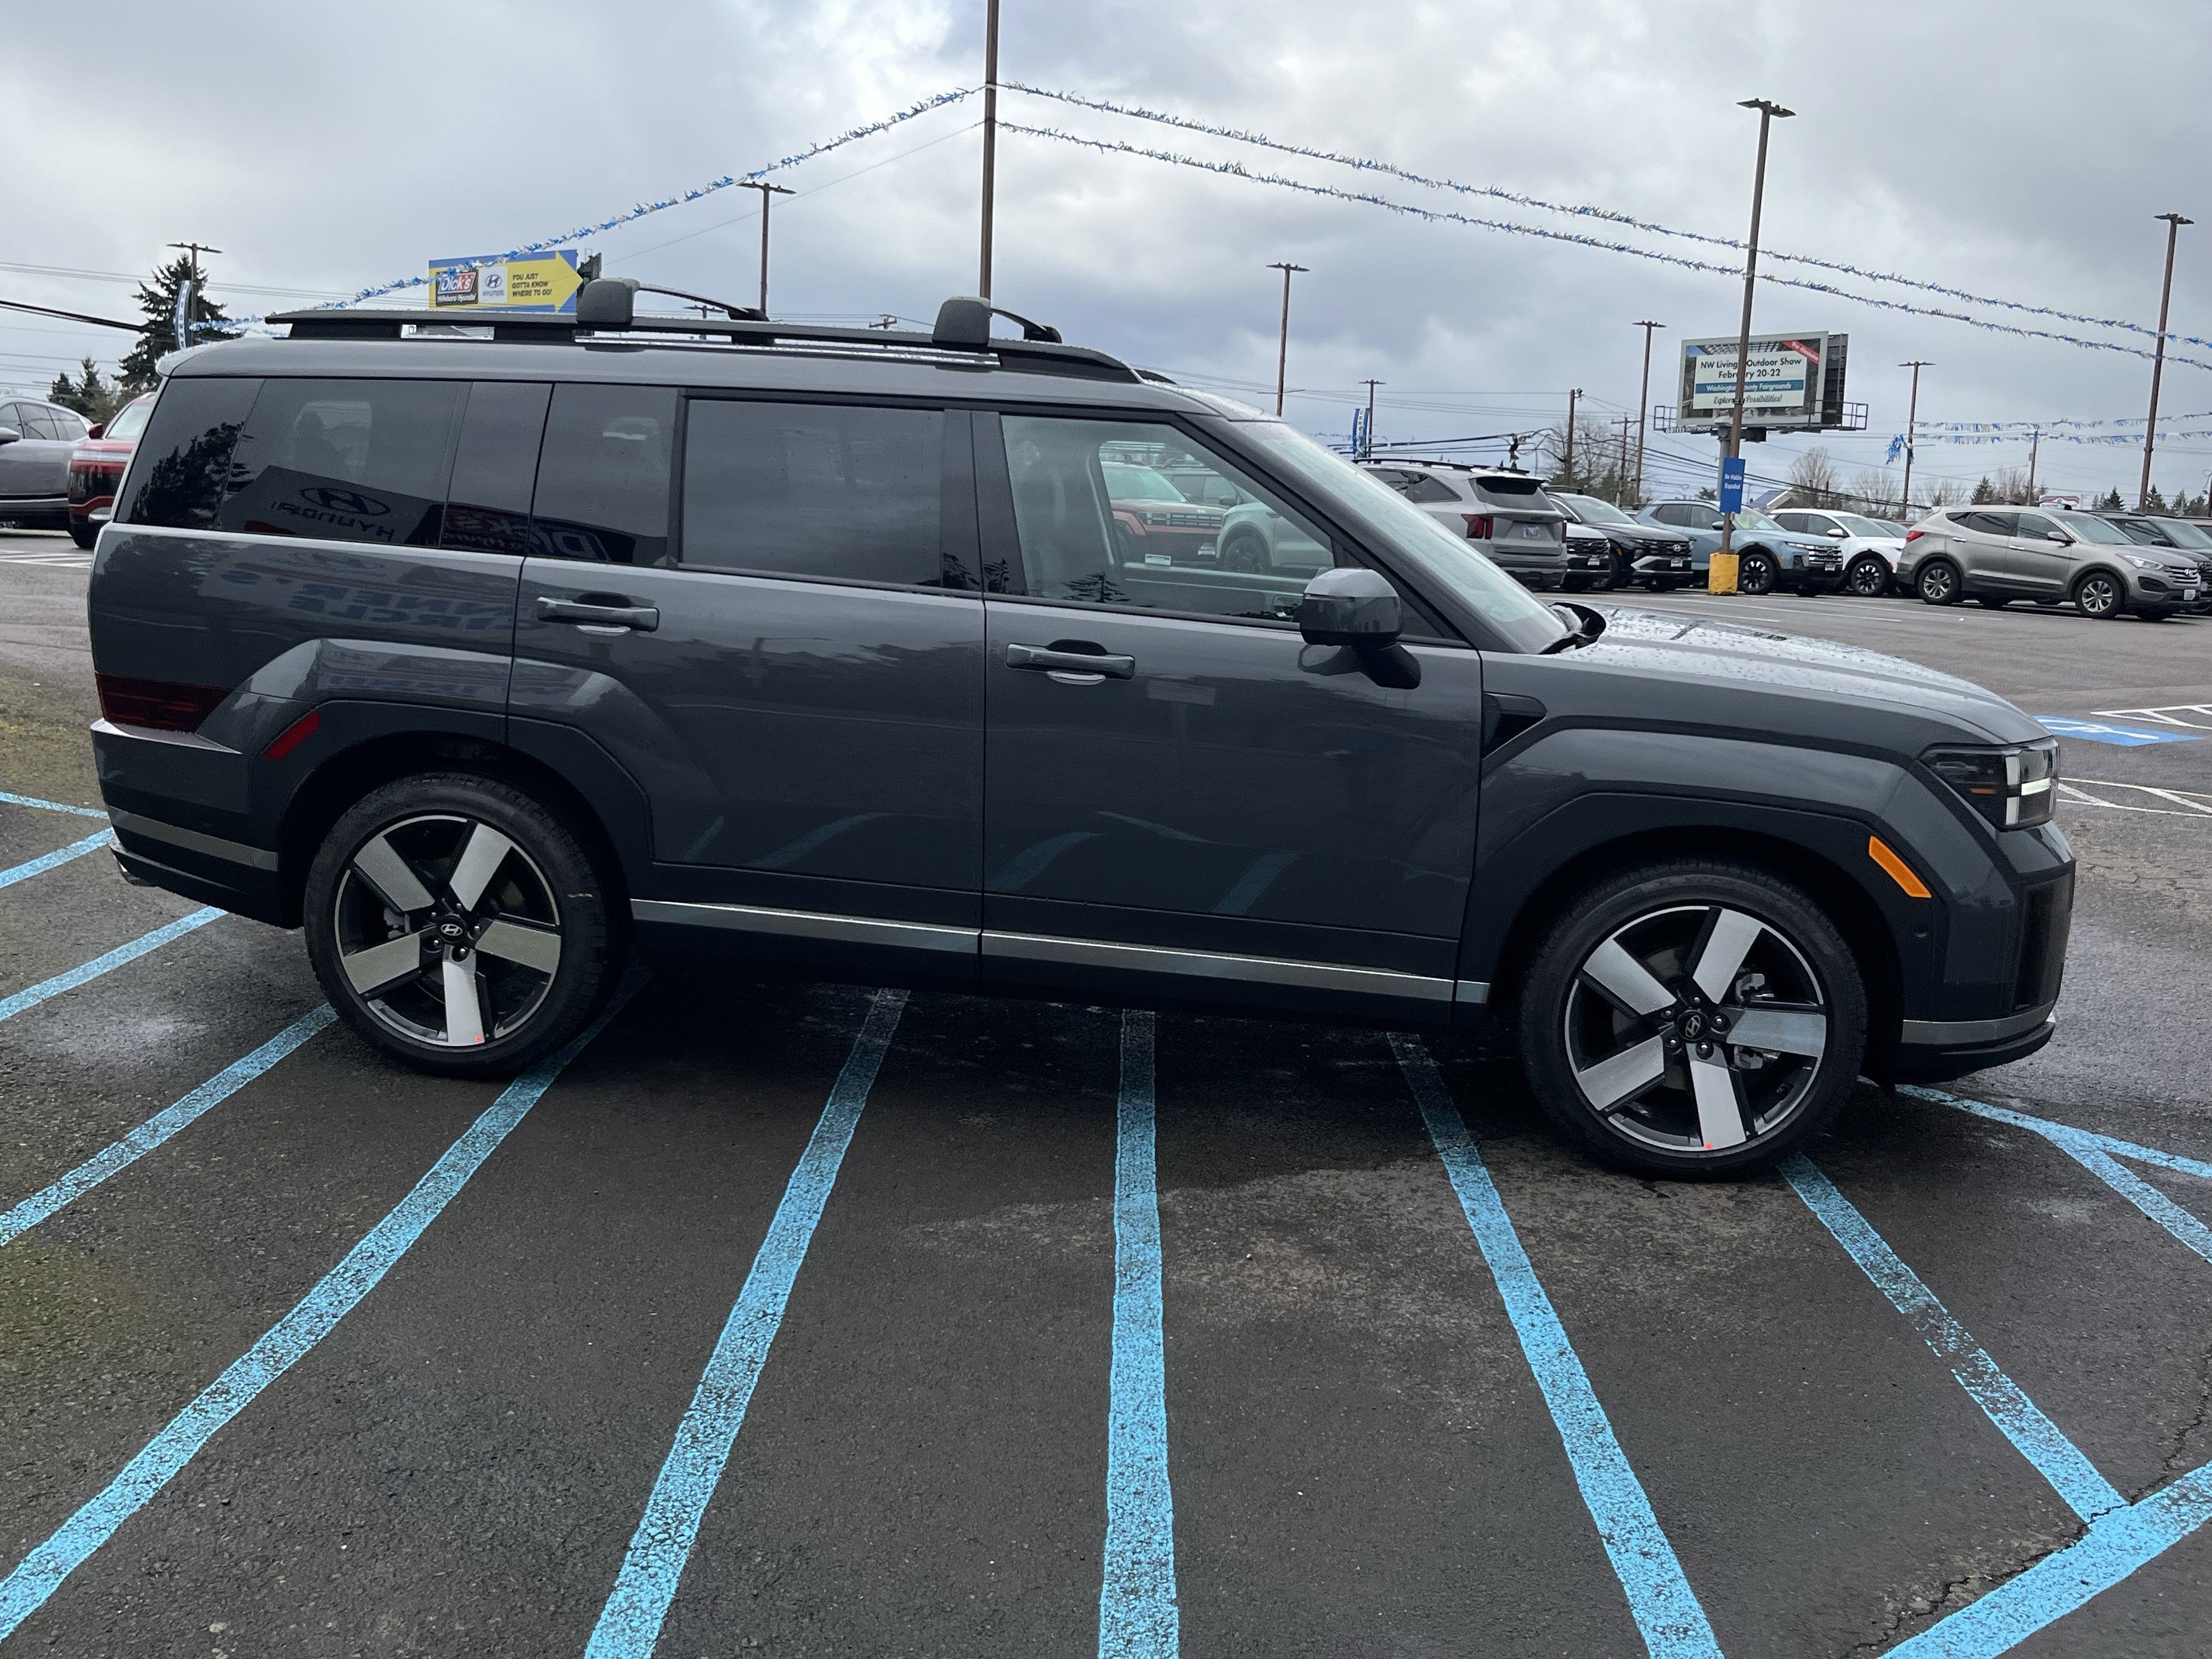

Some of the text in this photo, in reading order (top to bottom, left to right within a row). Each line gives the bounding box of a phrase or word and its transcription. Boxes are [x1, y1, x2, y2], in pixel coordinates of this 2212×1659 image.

[441, 275, 473, 291] Dick's
[1701, 358, 1802, 370] NW Living Outdoor Show
[1757, 369, 1781, 377] 20-22
[1759, 382, 1791, 391] Fairgrounds
[1746, 394, 1782, 403] Possibilities!
